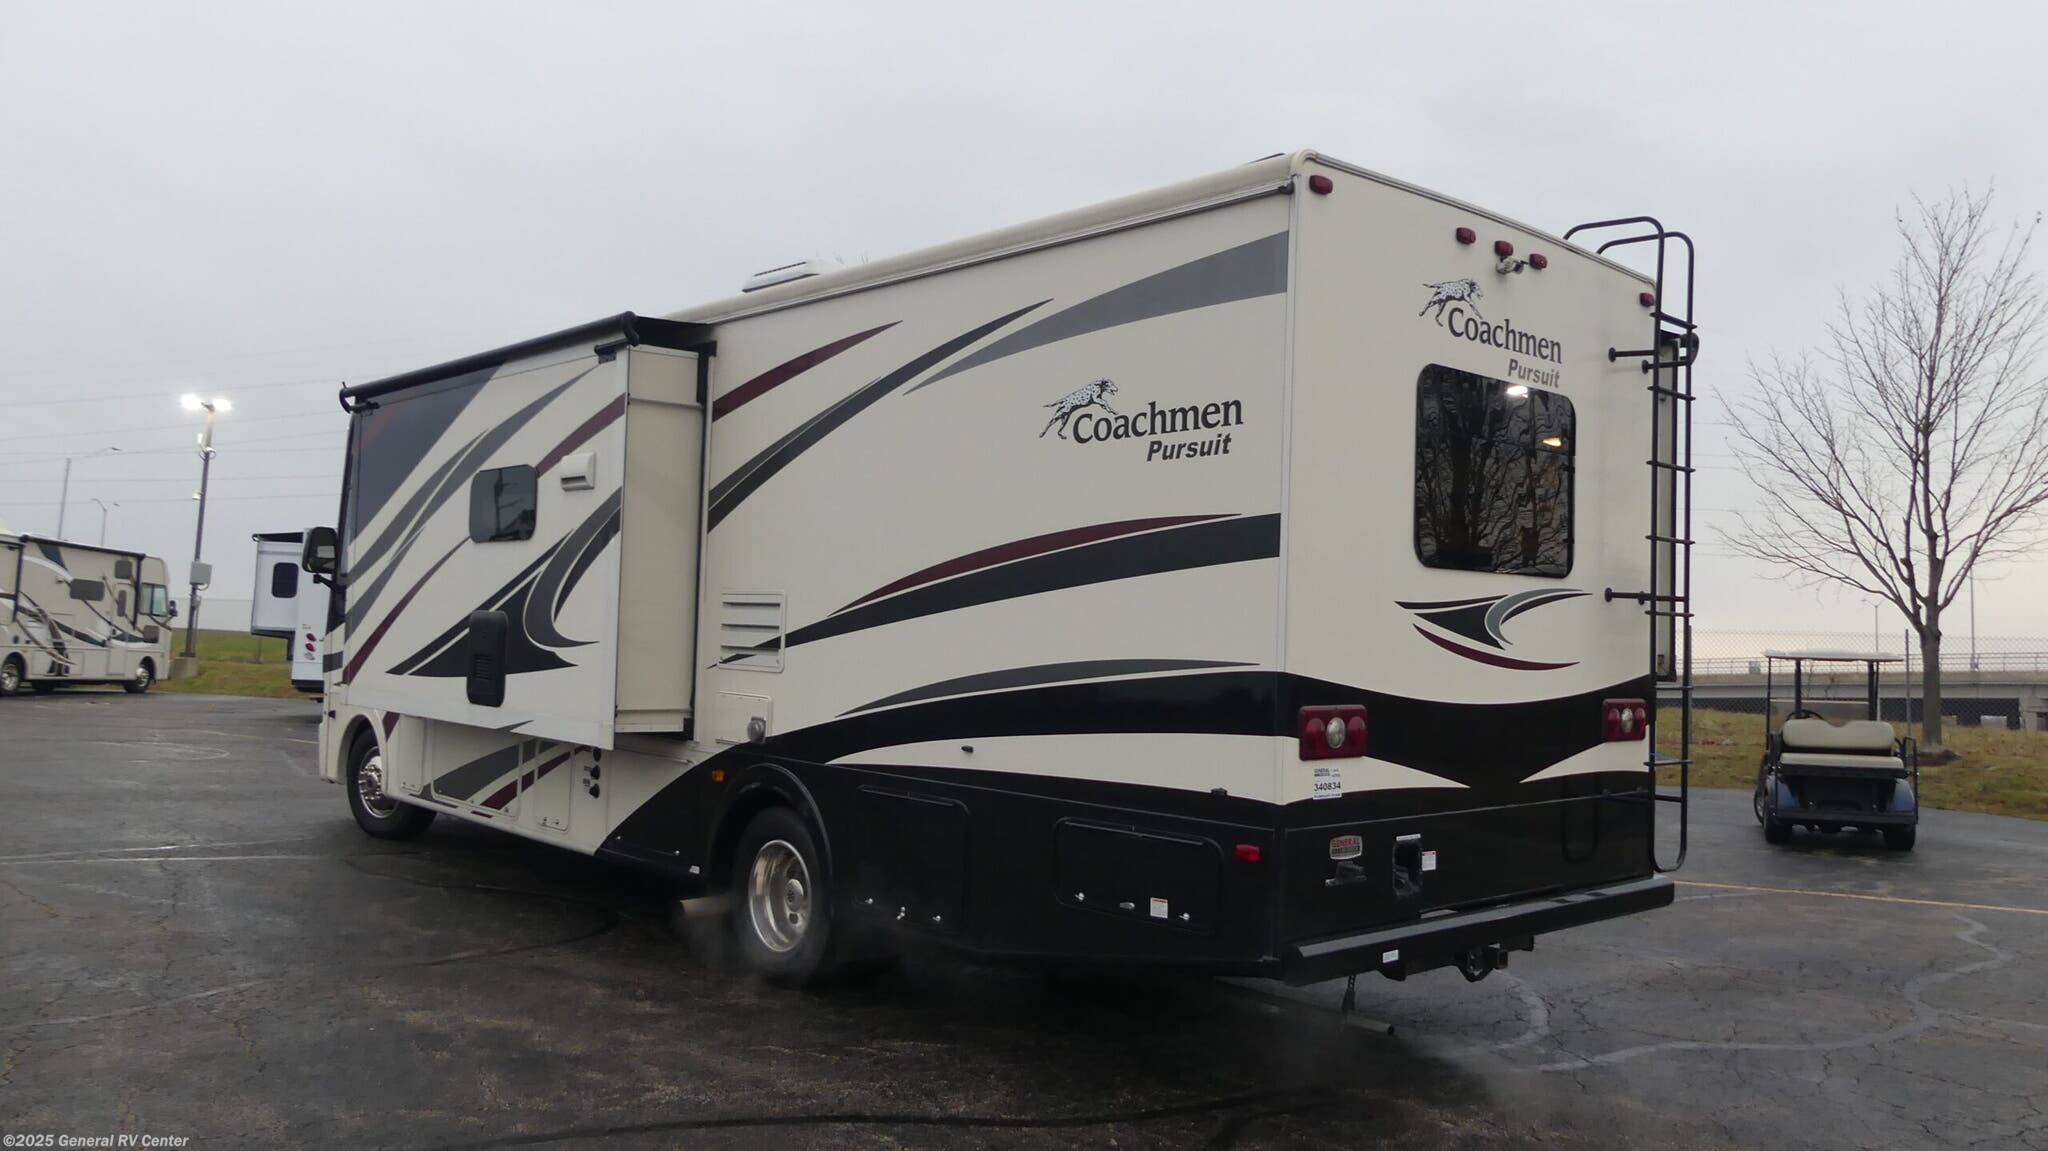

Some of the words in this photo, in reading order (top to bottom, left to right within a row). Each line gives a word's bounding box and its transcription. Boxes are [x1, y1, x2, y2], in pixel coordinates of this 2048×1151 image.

[1448, 307, 1562, 364] Coachmen
[1508, 358, 1560, 388] Pursuit
[1073, 399, 1244, 444] Coachmen
[1146, 432, 1232, 461] Pursuit
[1314, 781, 1341, 791] 340834
